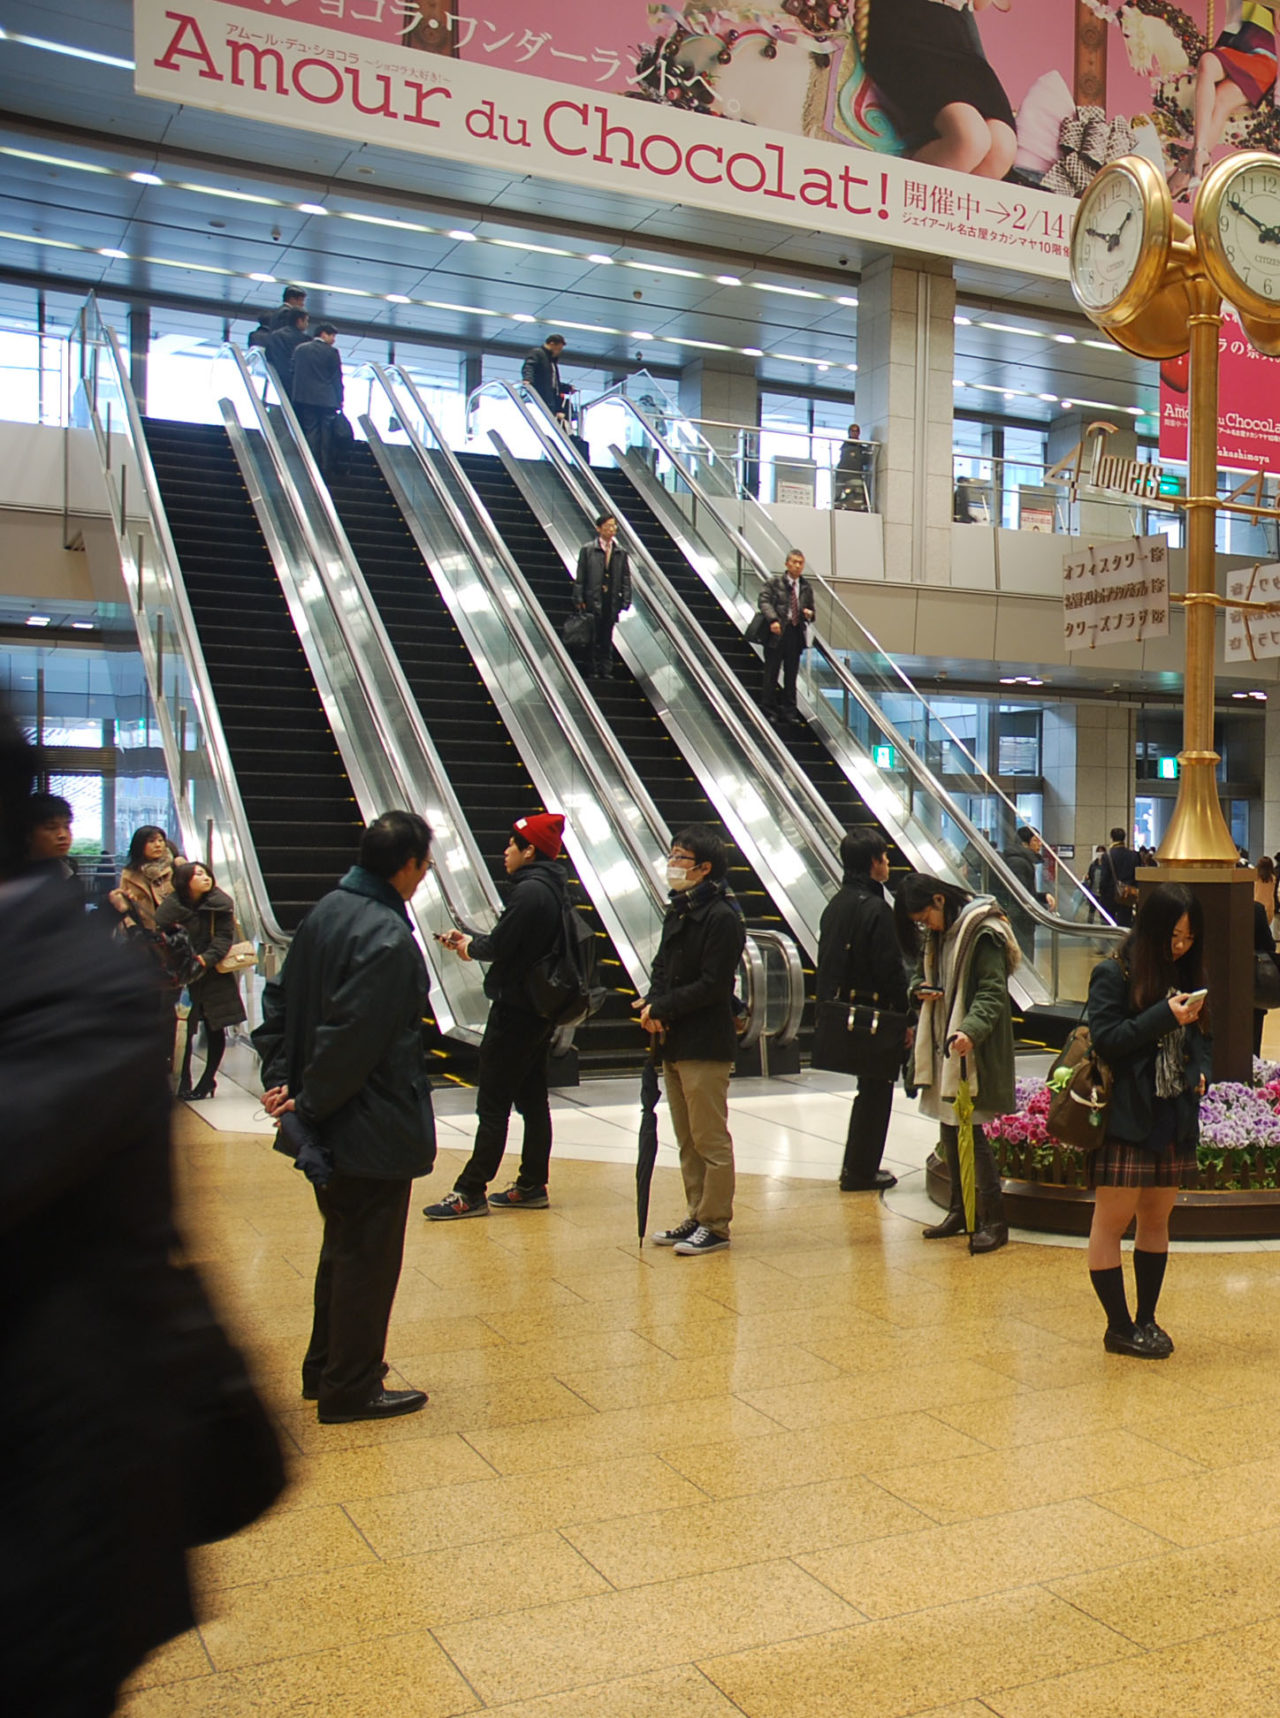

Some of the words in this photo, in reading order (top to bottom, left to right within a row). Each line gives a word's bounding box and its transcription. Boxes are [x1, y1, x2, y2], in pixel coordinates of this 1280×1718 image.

[226, 23, 359, 64] アムール・デュ・ショコラ
[264, 0, 723, 101] ョコラ・ワンダーランドへ
[154, 10, 452, 128] Amour
[465, 99, 531, 148] du
[543, 100, 889, 220] Chocolat!
[1241, 175, 1255, 194] 11
[1263, 175, 1278, 194] 12
[904, 179, 981, 221] 開催中
[1220, 215, 1230, 233] 9
[1226, 245, 1235, 263] 8
[1242, 266, 1251, 285] 7
[1263, 278, 1273, 296] 6
[1086, 421, 1164, 499] Towers
[1217, 445, 1270, 465] akashimaya
